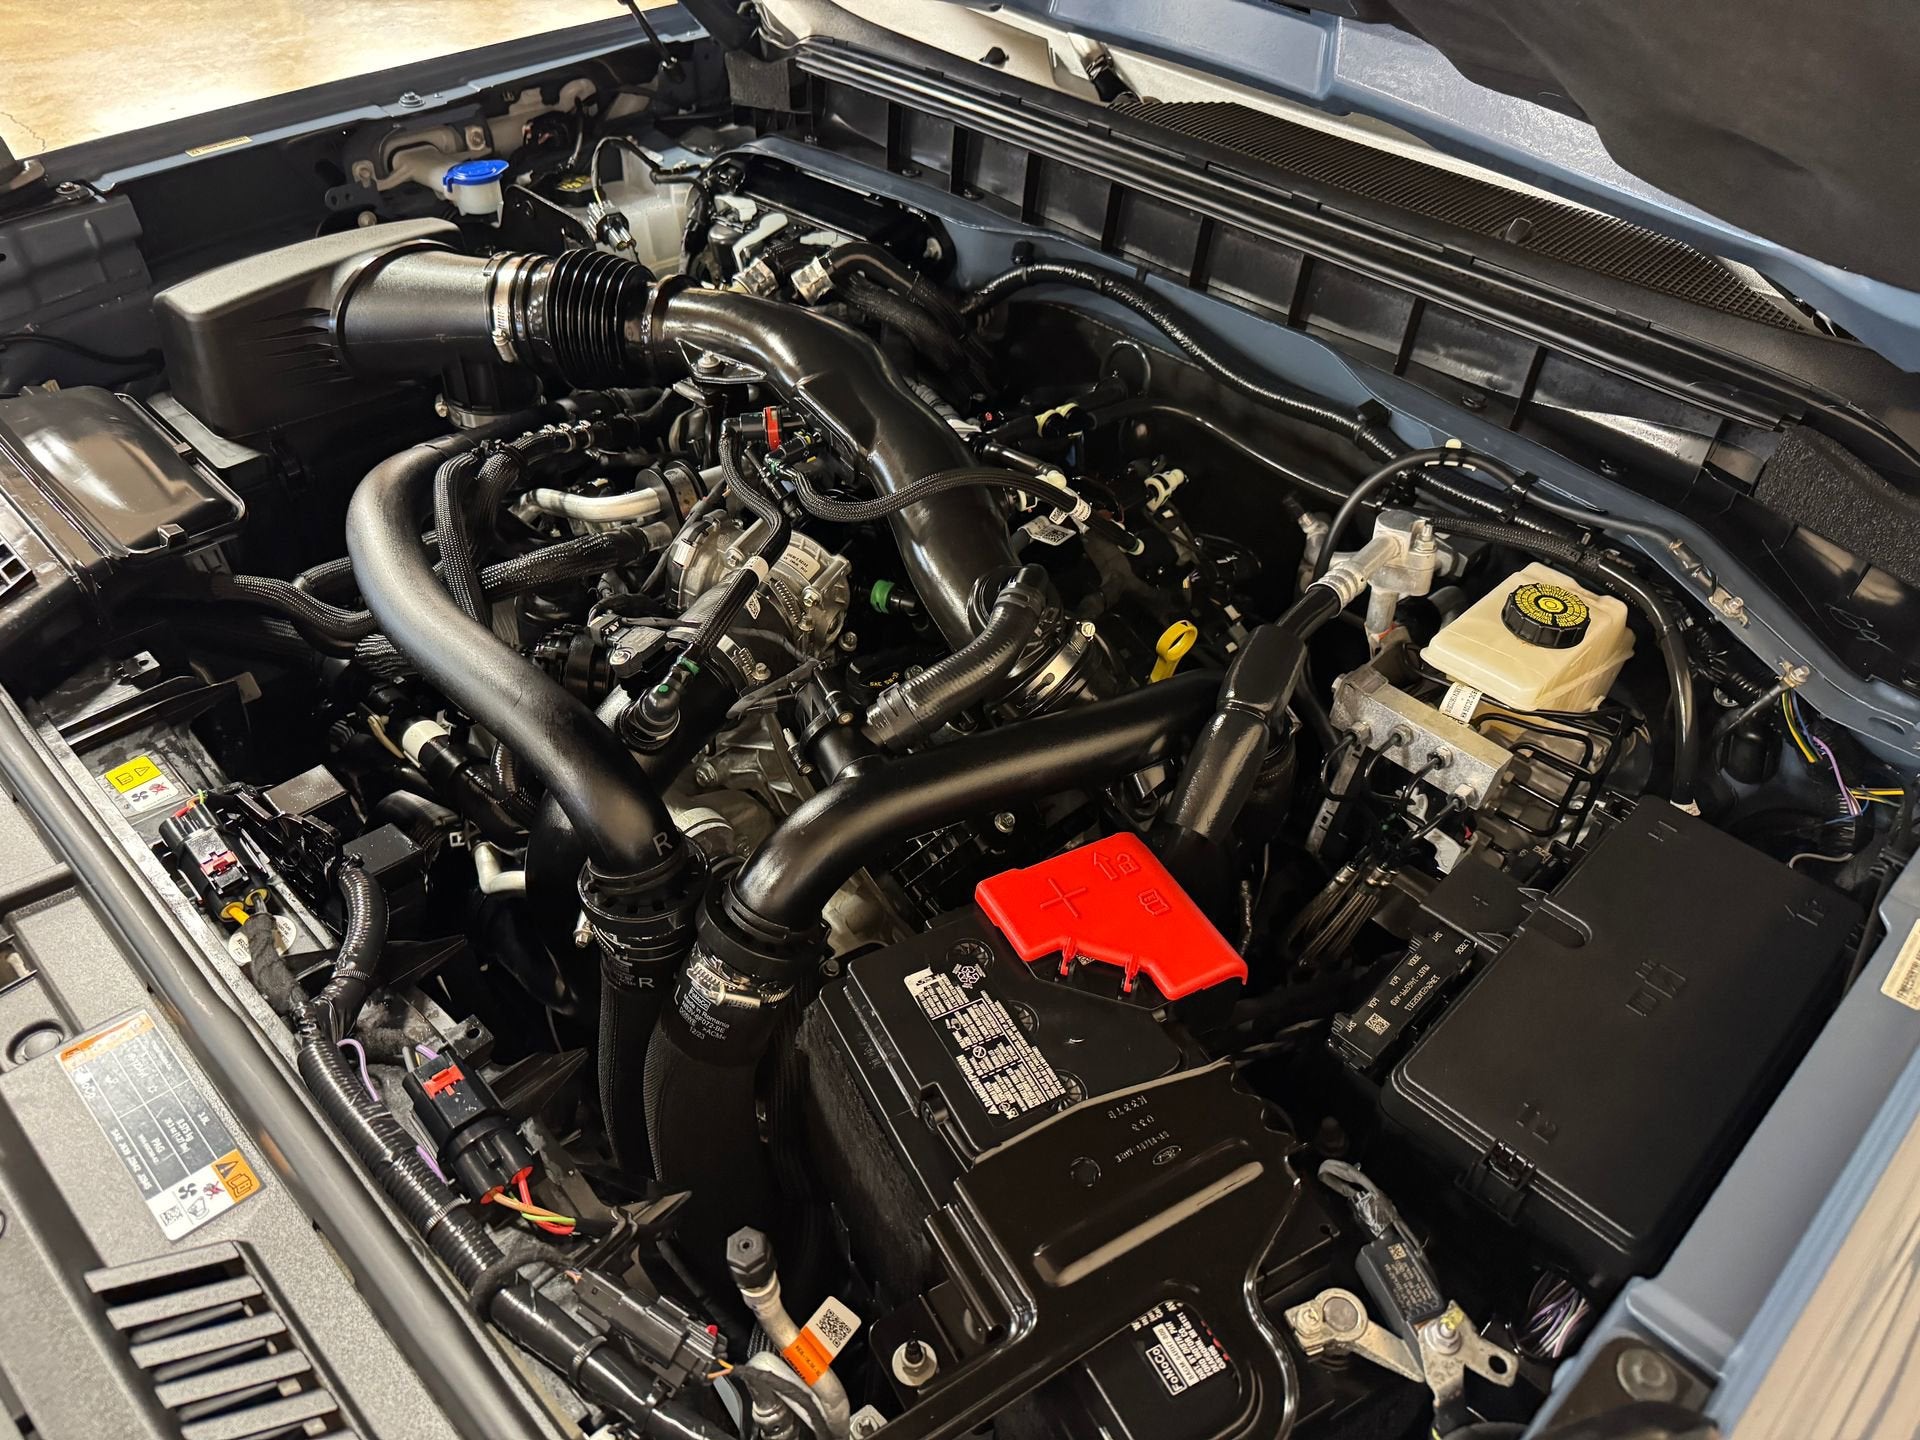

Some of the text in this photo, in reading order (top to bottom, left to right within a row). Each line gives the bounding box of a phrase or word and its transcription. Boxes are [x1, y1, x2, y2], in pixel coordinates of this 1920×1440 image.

[652, 831, 673, 857] R
[638, 977, 656, 989] R
[688, 989, 710, 1009] FoMoCo
[684, 994, 696, 1009] Made
[702, 1011, 730, 1028] Romania
[956, 1055, 993, 1107] DANGER/POISON
[151, 1137, 166, 1154] PAG
[1165, 1321, 1178, 1334] PAR
[1177, 1312, 1192, 1330] 48121
[1188, 1329, 1197, 1338] MI
[1178, 1326, 1213, 1376] FORD MOTOR CO.
[1186, 1355, 1197, 1364] BY
[1152, 1348, 1183, 1392] FoMoCo
[1193, 1363, 1207, 1380] DIST.
